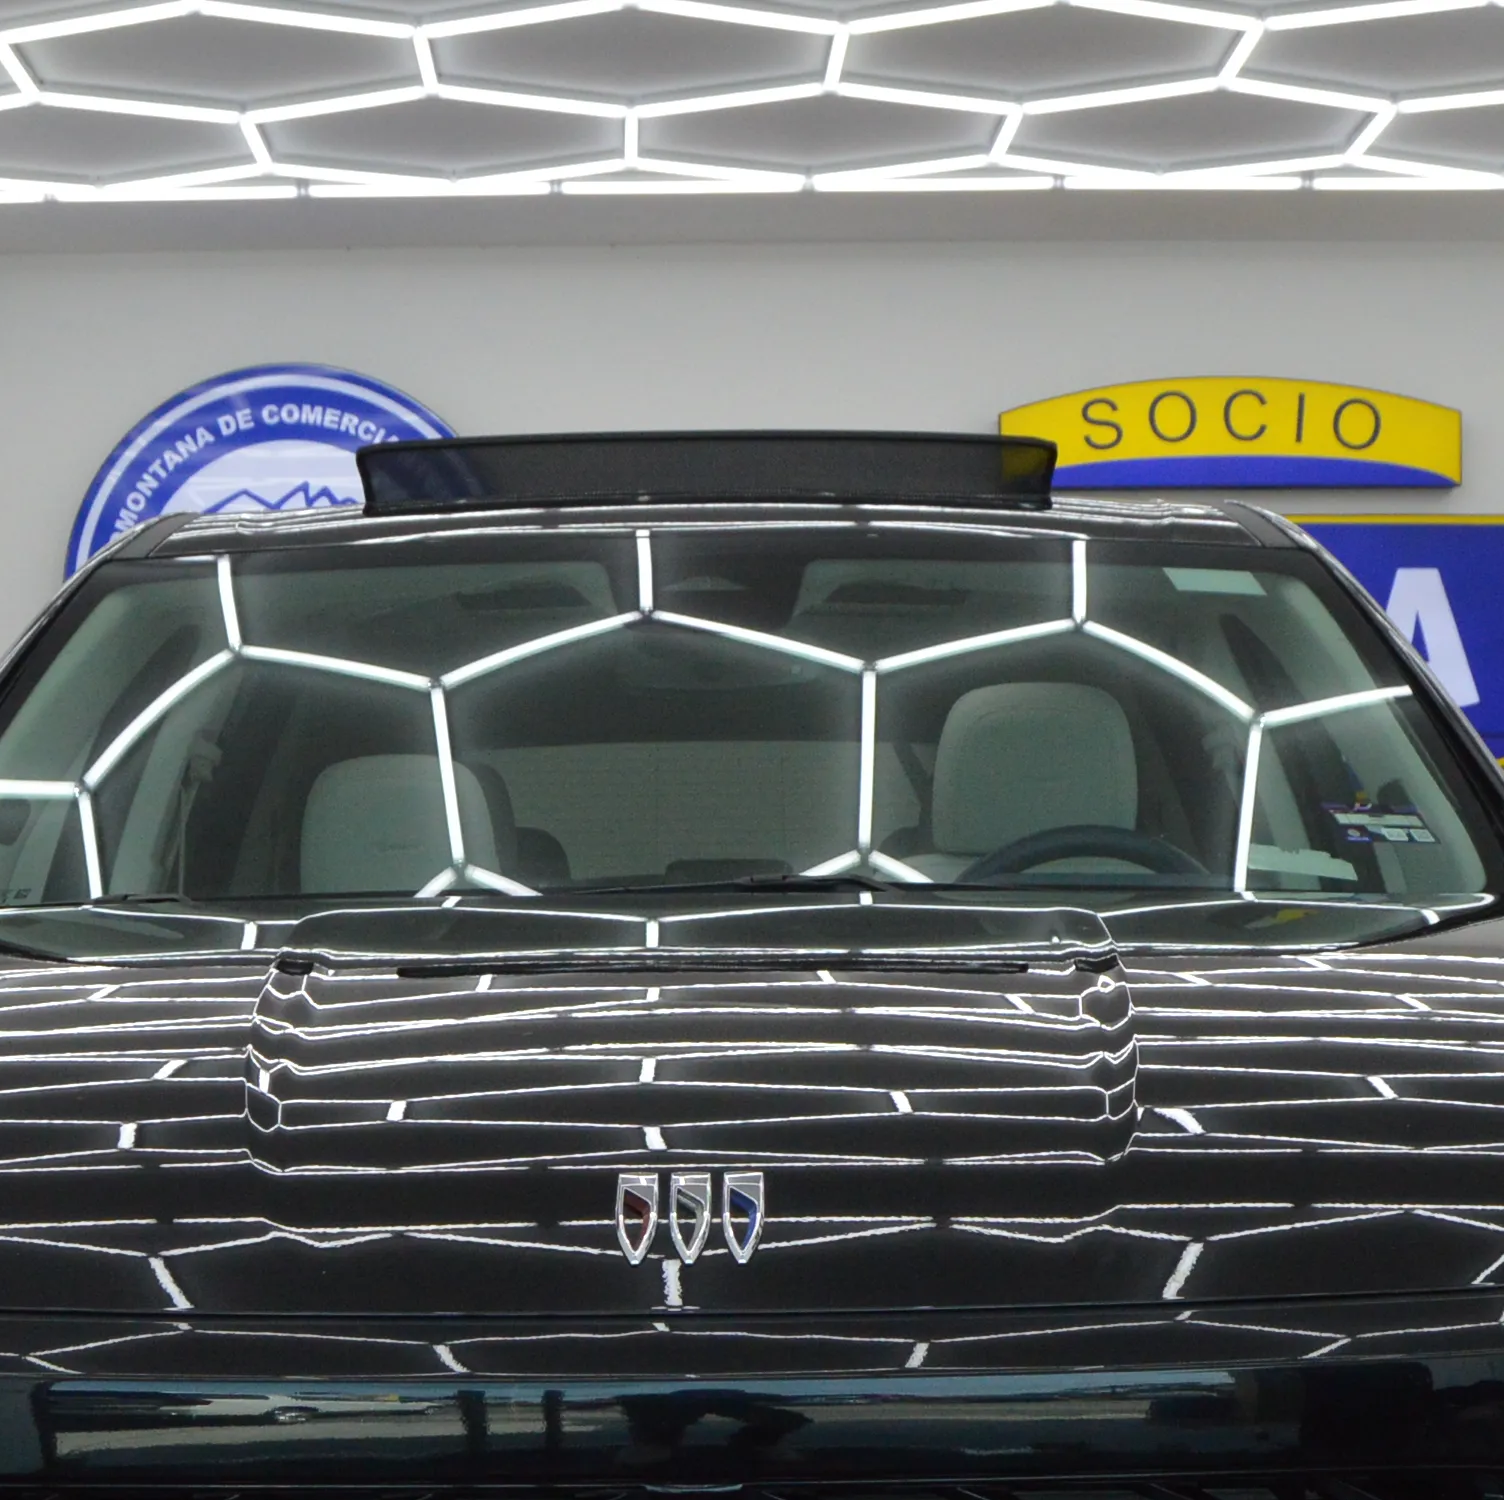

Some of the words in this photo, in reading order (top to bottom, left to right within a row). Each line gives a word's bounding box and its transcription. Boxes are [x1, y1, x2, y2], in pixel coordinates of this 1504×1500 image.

[1080, 389, 1383, 450] SOCIO
[108, 426, 215, 544] MONTANA
[217, 408, 255, 437] DE
